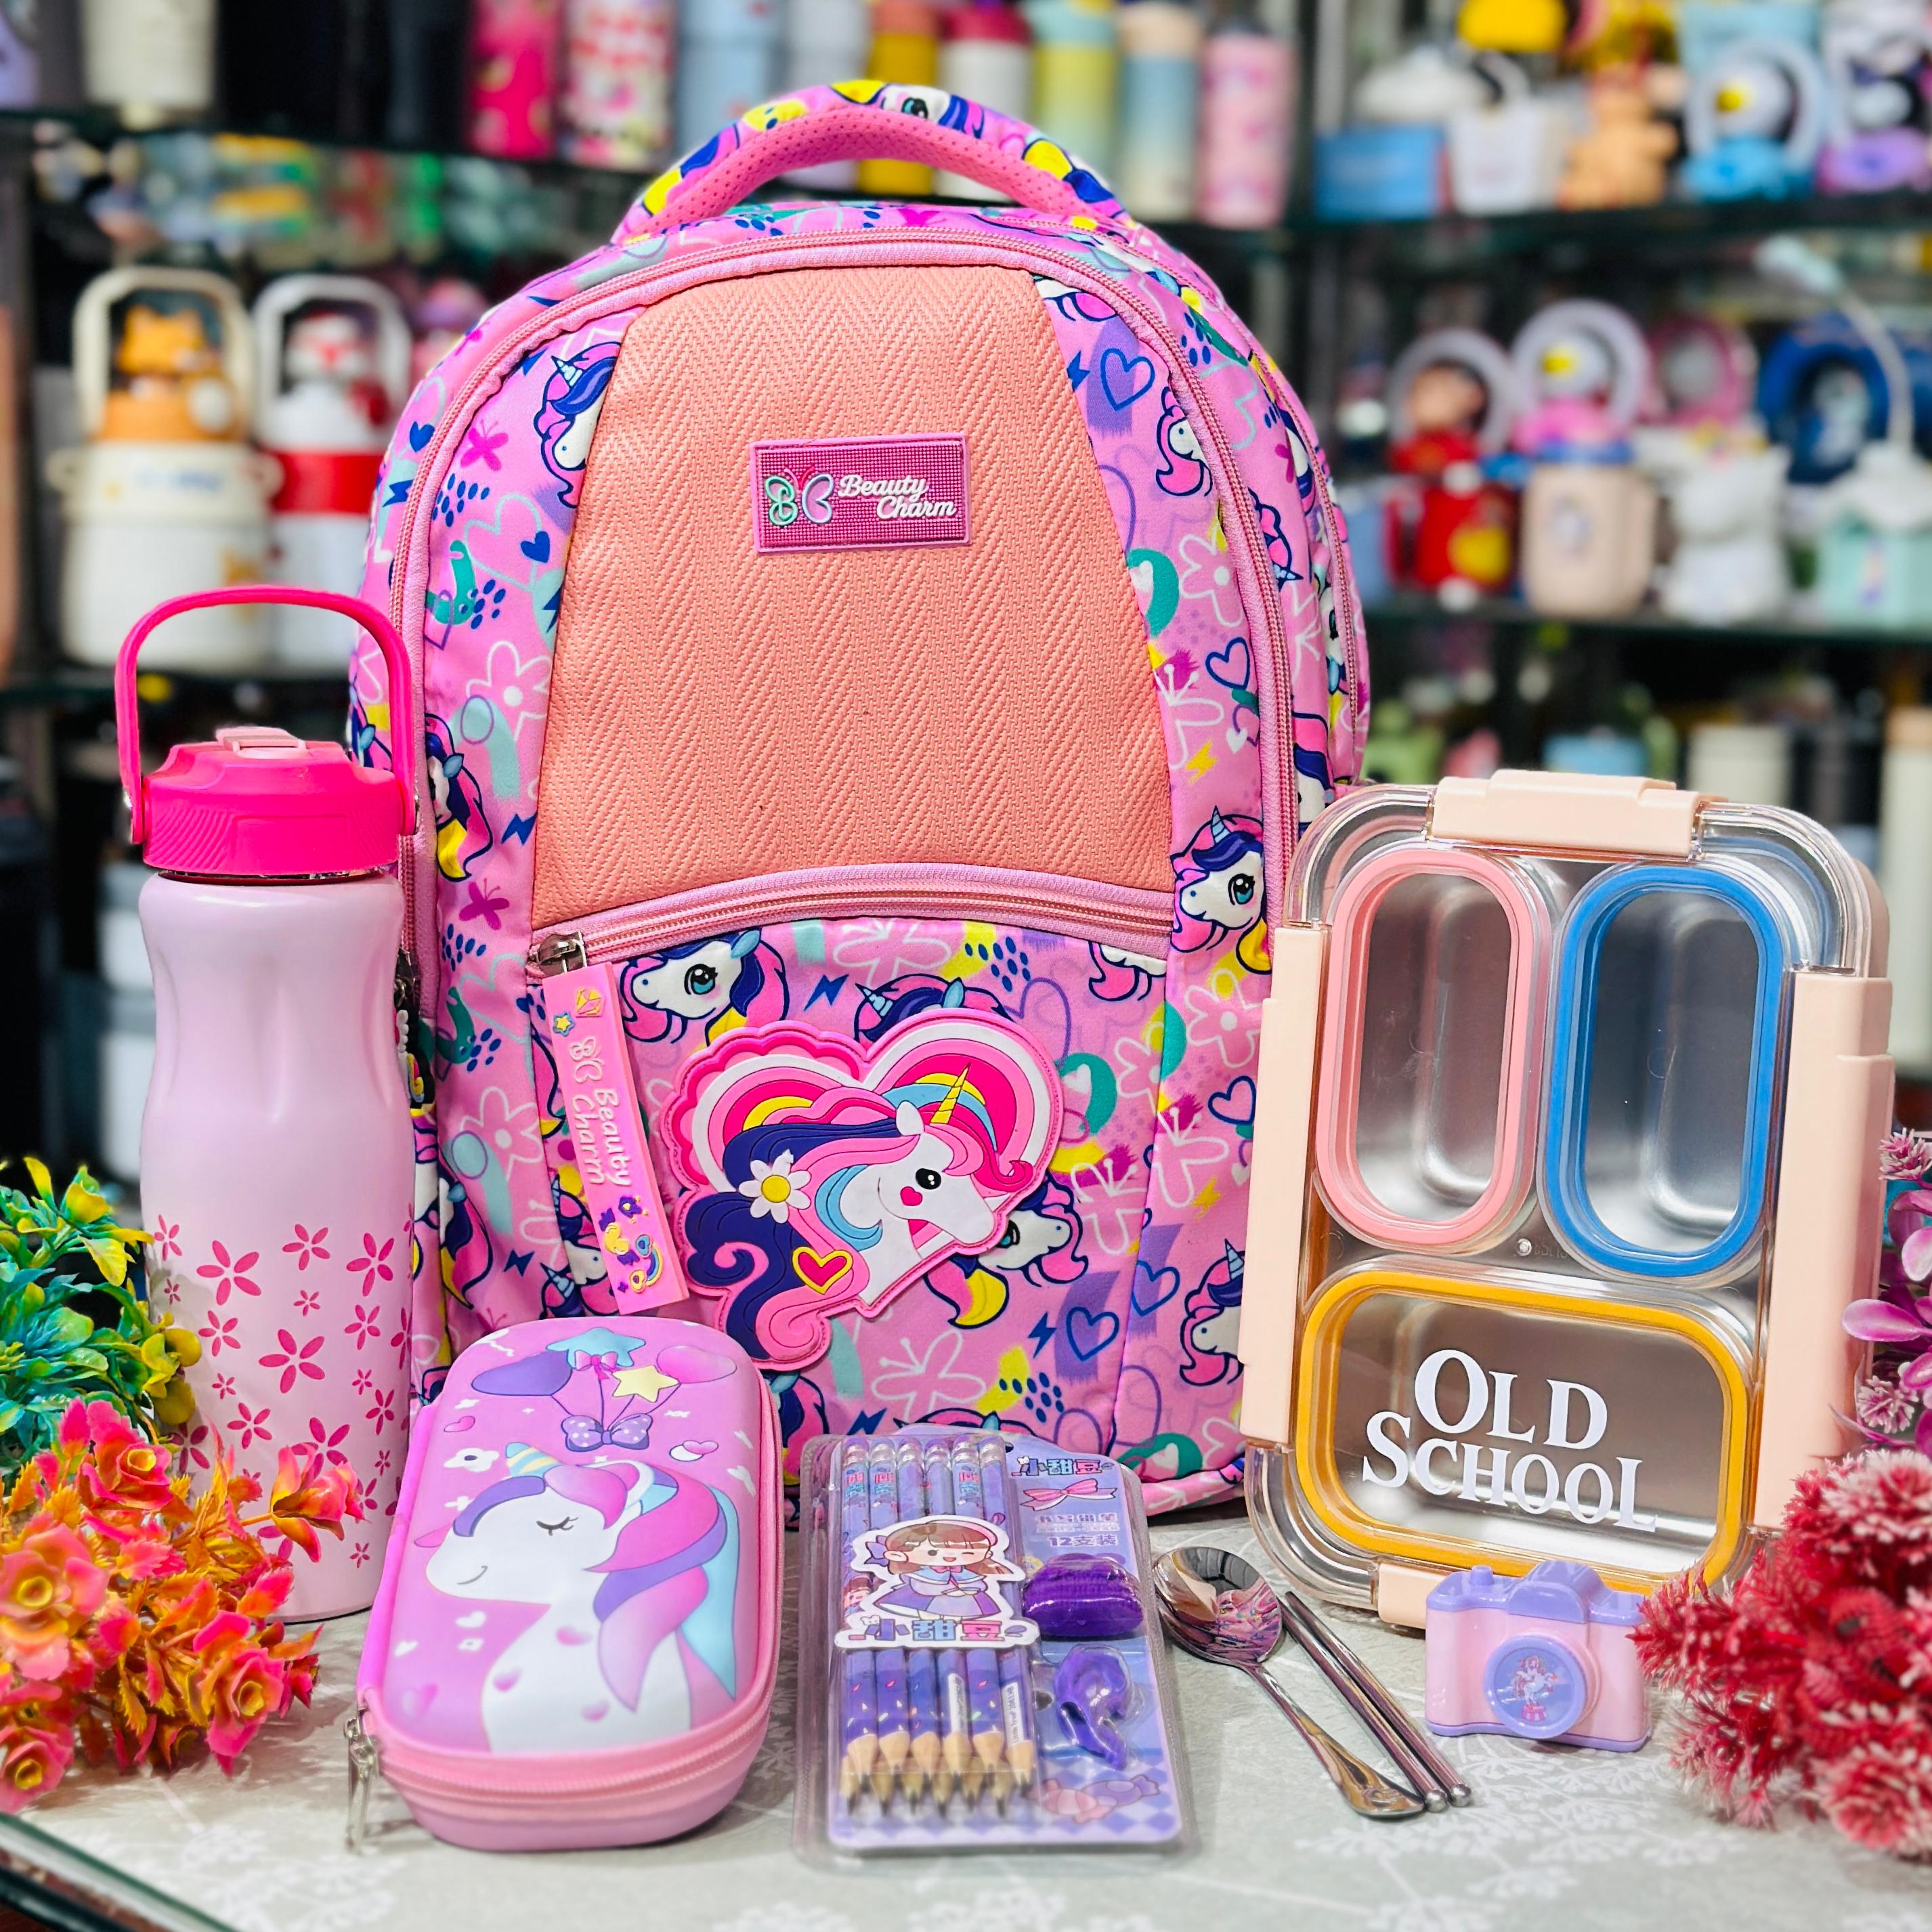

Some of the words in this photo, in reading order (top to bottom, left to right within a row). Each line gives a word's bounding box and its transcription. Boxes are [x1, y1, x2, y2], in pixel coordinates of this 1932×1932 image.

[837, 474, 929, 501] Beauty
[877, 496, 956, 519] Charm
[571, 1094, 605, 1185] Charm
[594, 1088, 632, 1187] Beauty
[1414, 1349, 1608, 1449] OLD
[1012, 1457, 1102, 1476] 小甜豆
[1362, 1411, 1656, 1532] SCHOOL
[1050, 1534, 1117, 1547] 12支装
[849, 1618, 1006, 1641] 小甜豆
